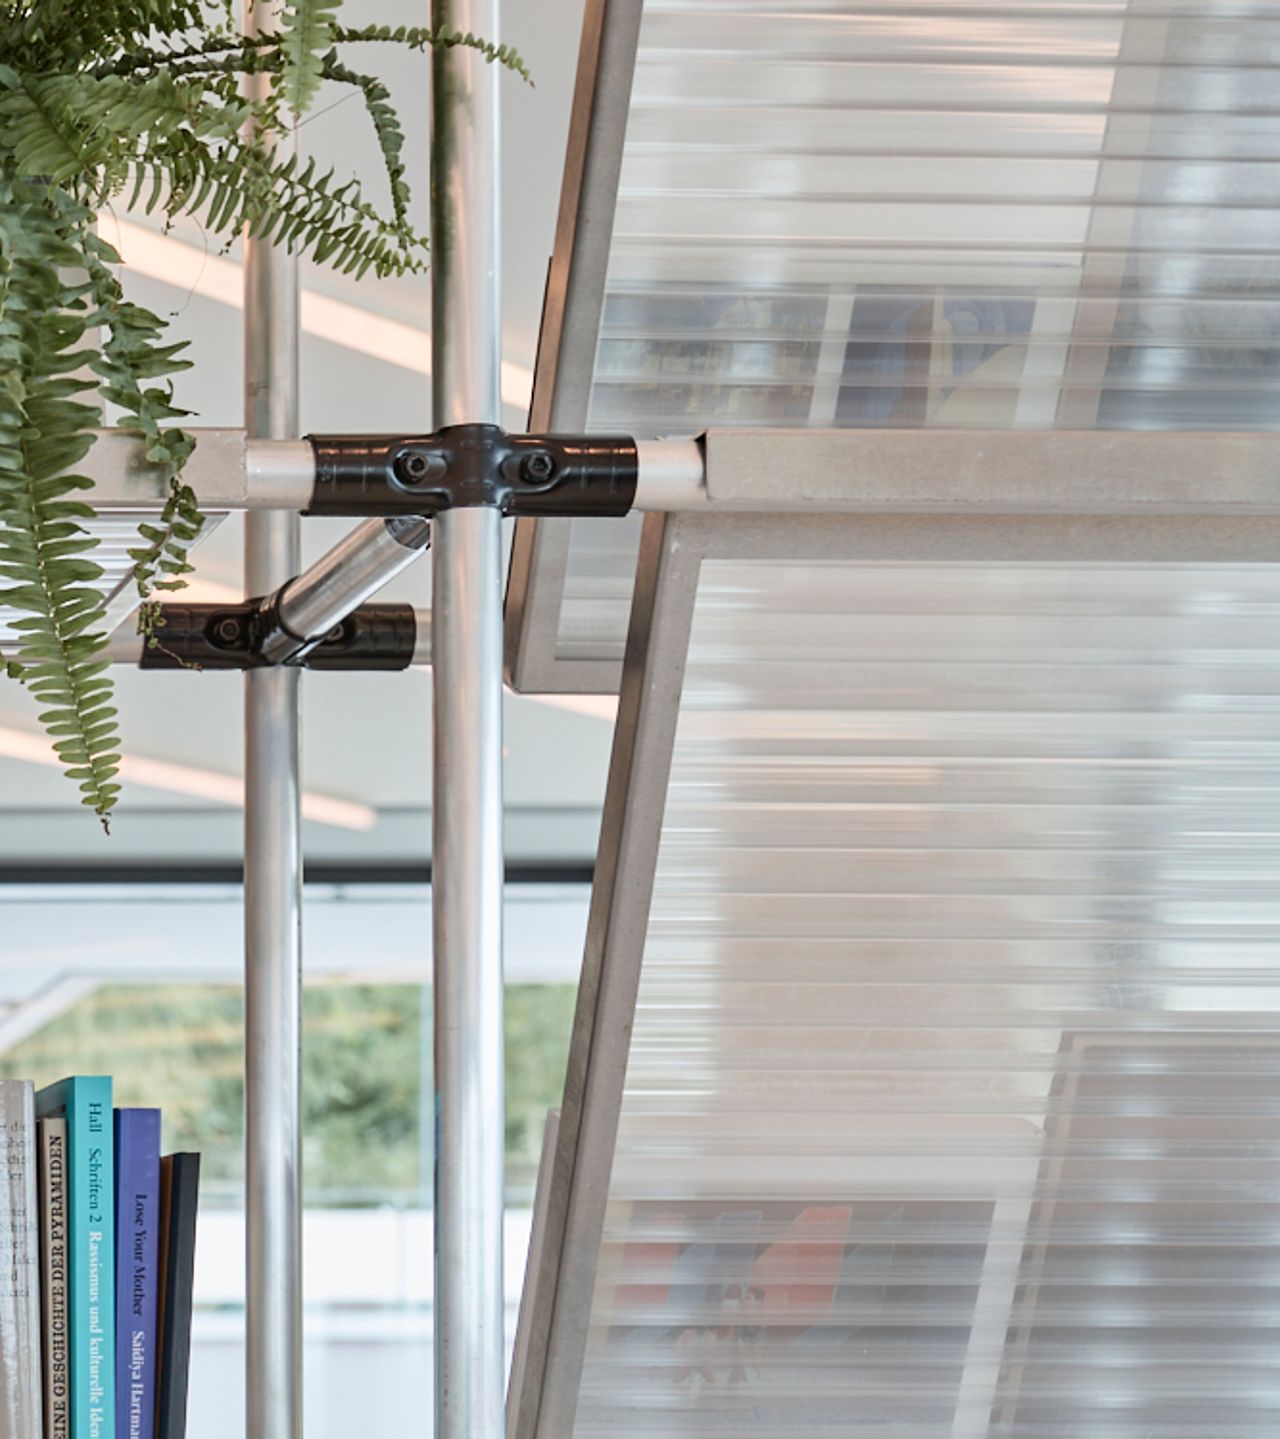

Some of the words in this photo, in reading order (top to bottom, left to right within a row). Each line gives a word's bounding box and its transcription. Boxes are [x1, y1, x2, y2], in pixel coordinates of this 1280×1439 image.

[88, 1102, 102, 1133] Hall
[49, 1135, 64, 1241] PYRAMIDEN
[88, 1148, 102, 1210] Schriften
[88, 1213, 102, 1223] 2
[134, 1193, 148, 1226] Lose
[51, 1242, 65, 1282] DER
[88, 1230, 103, 1303] Rassismus
[133, 1229, 148, 1262] Your
[132, 1264, 147, 1318] Mother
[51, 1285, 66, 1397] GESCHICHTE
[89, 1306, 102, 1333] und
[89, 1337, 104, 1404] kulturelle
[128, 1330, 146, 1380] Saidiya
